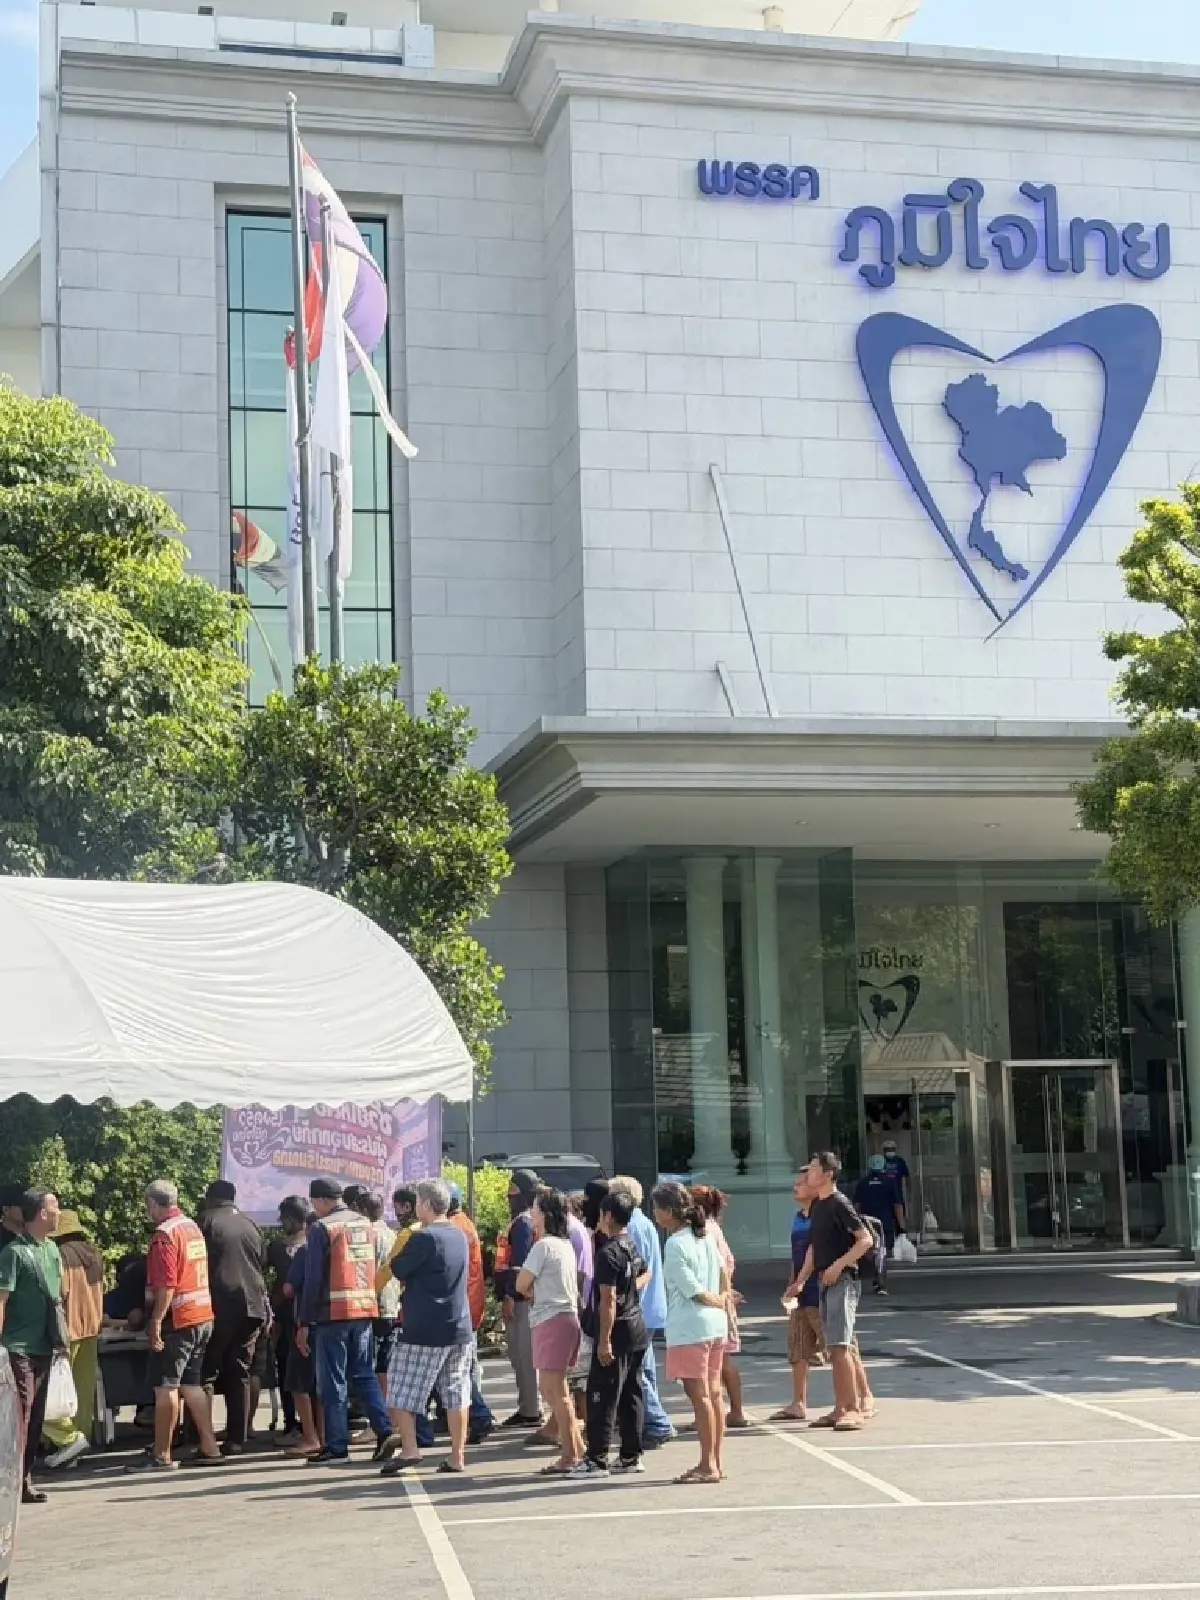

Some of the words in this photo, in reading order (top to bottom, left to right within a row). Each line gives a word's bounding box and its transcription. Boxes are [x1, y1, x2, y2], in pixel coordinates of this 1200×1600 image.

[697, 158, 820, 201] พรรค
[838, 177, 1171, 288] ภูมิใจไทย
[858, 946, 924, 968] มิใจไทย
